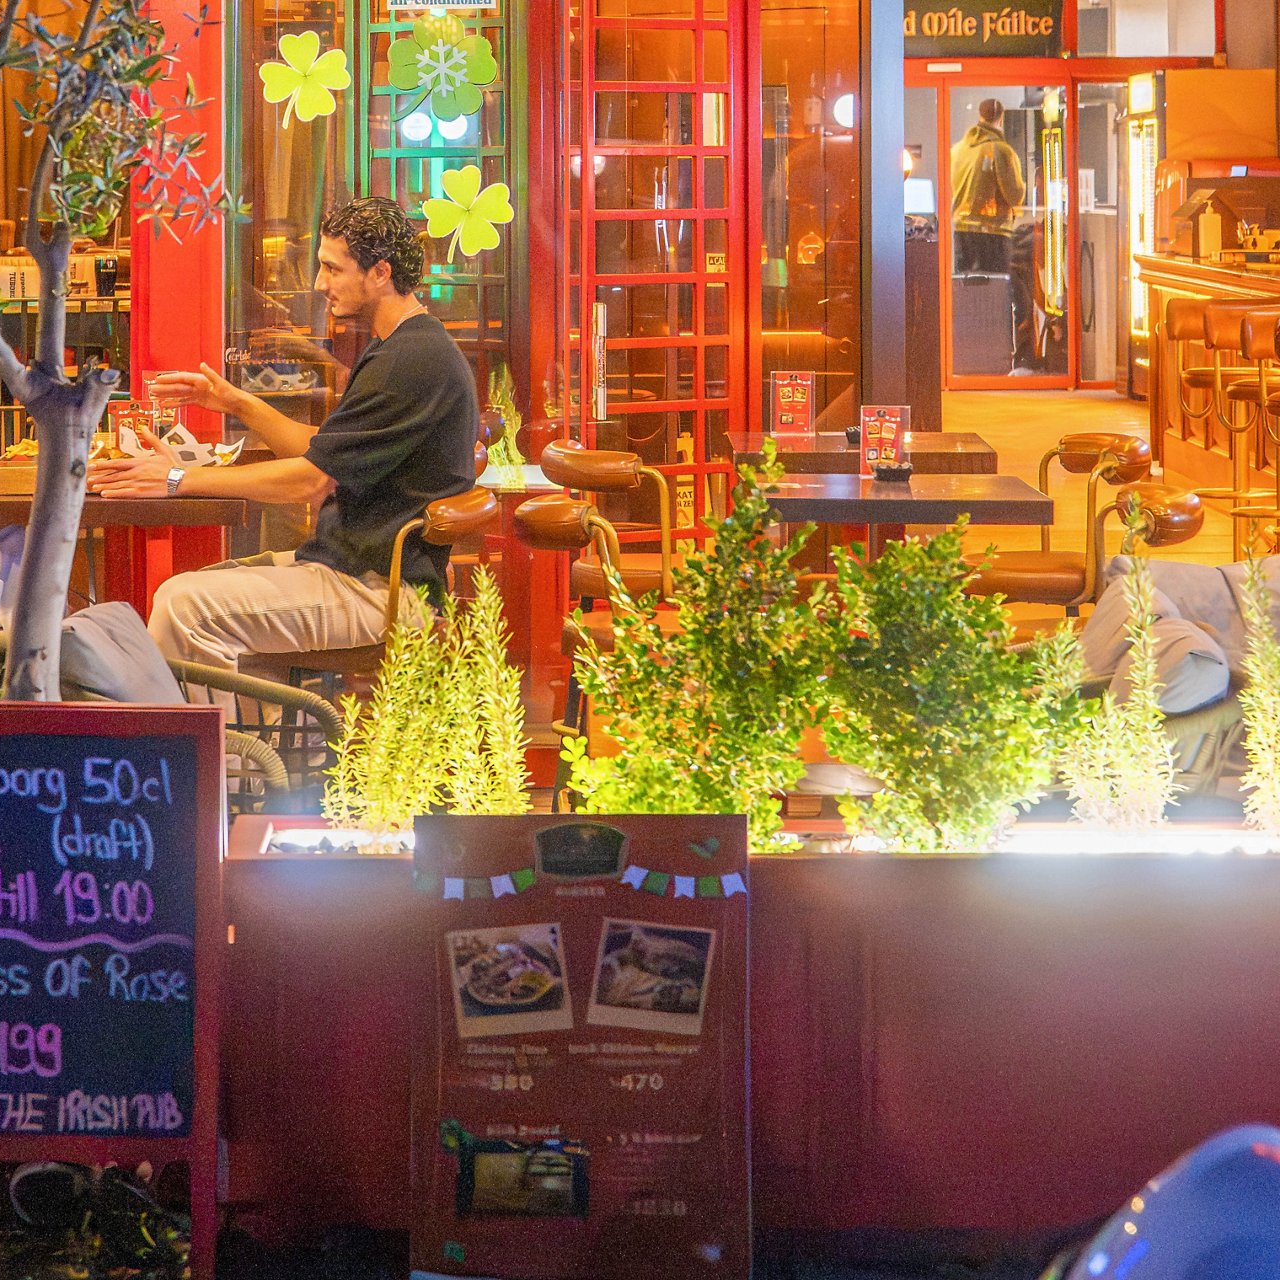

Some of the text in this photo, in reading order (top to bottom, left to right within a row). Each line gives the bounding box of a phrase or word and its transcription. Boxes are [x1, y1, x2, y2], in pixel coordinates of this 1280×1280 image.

[80, 757, 173, 806] 50cl
[51, 813, 154, 870] (draft)
[53, 870, 154, 926] 19:00
[57, 1088, 129, 1133] IRISH
